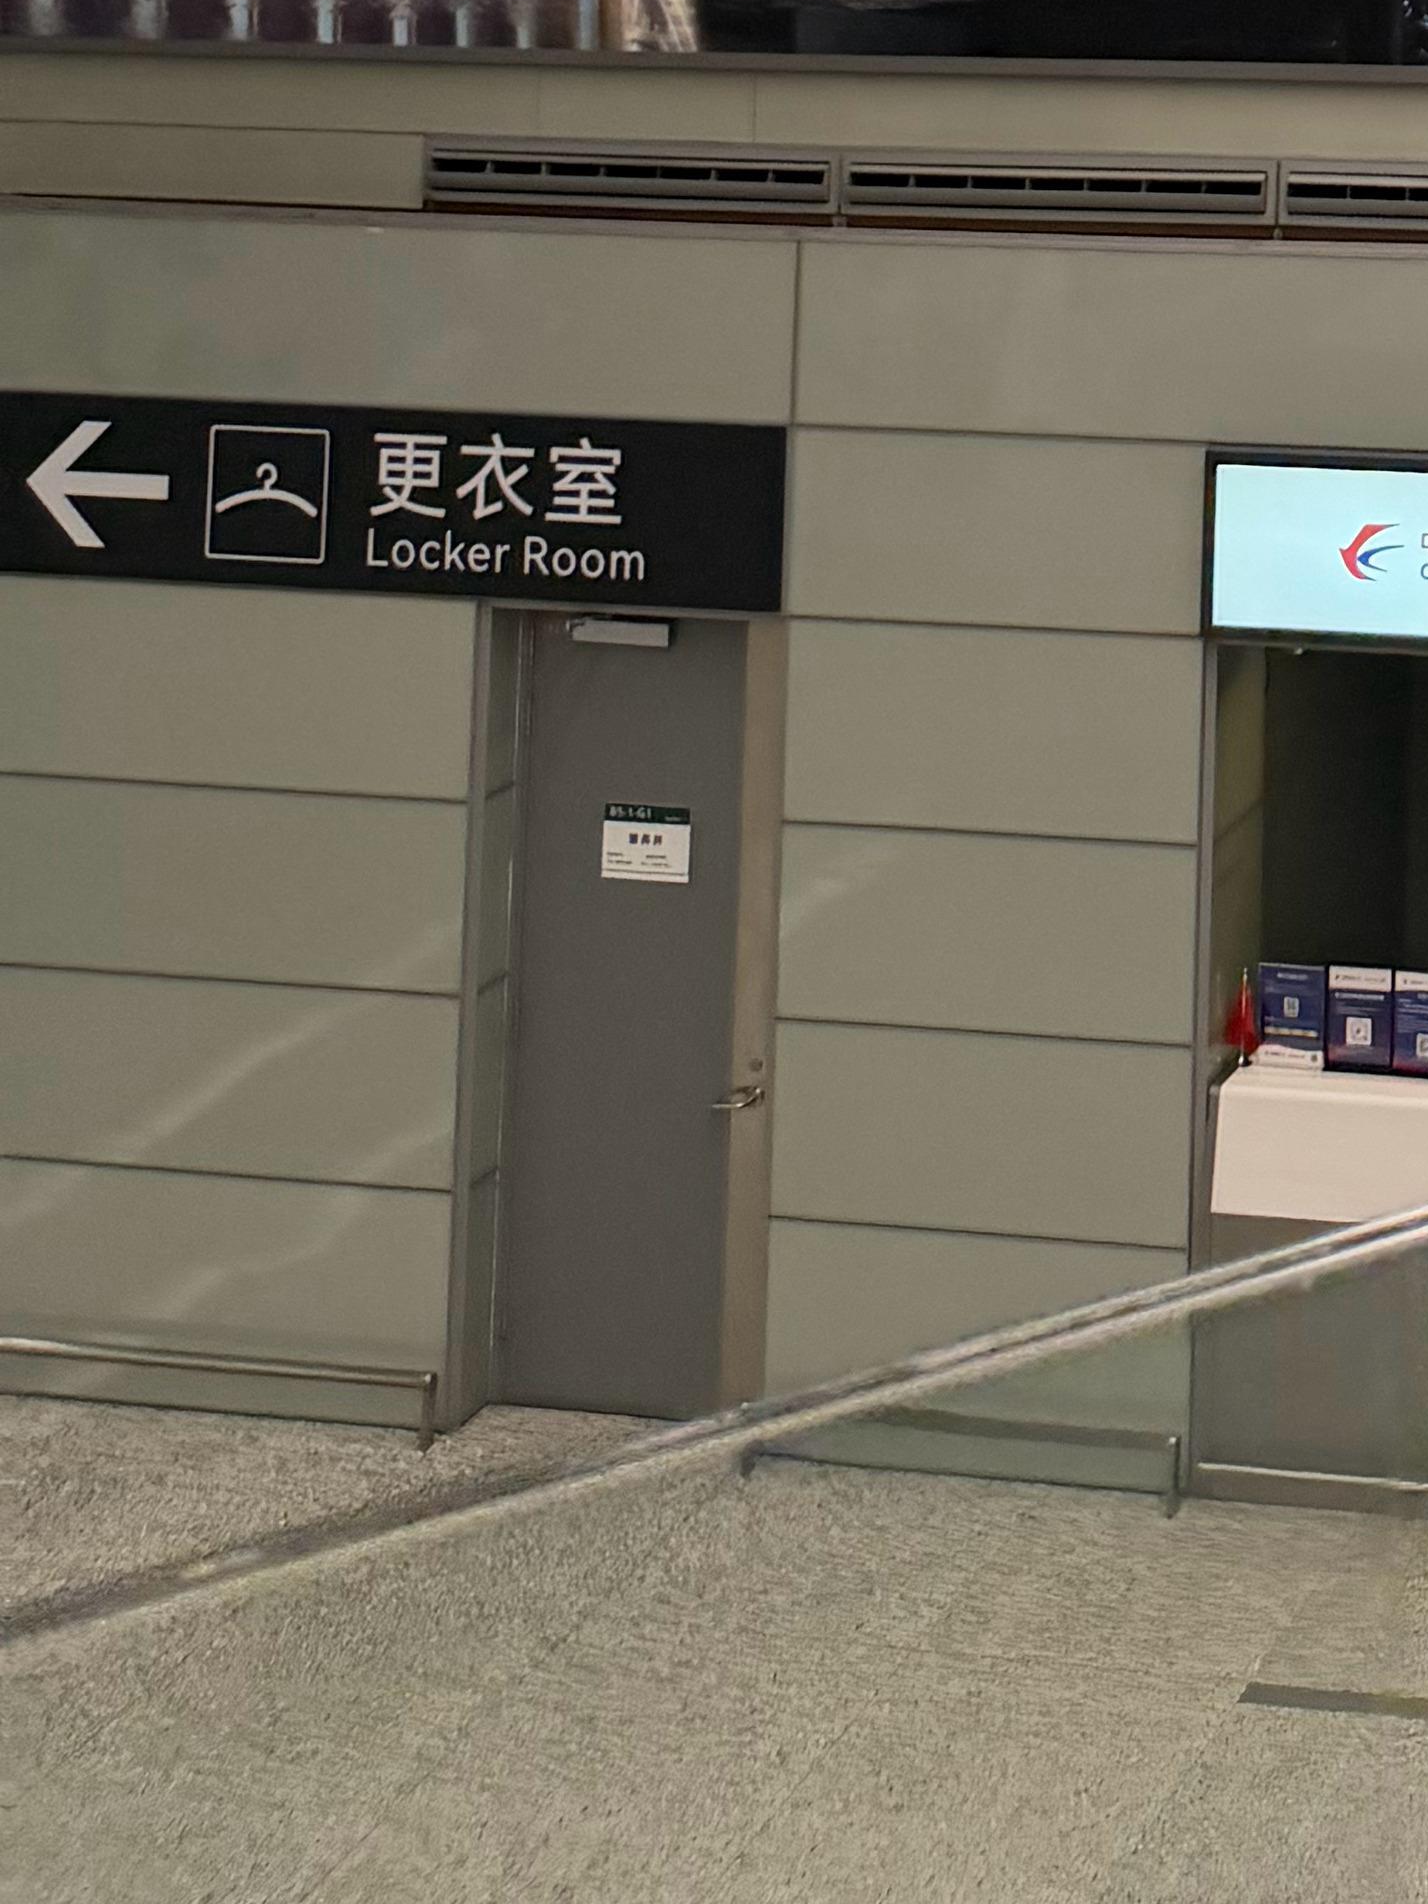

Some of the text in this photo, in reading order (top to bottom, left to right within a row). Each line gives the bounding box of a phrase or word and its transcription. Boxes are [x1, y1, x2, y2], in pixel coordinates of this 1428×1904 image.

[370, 432, 623, 525] 更衣室
[366, 527, 646, 582] Locker Room
